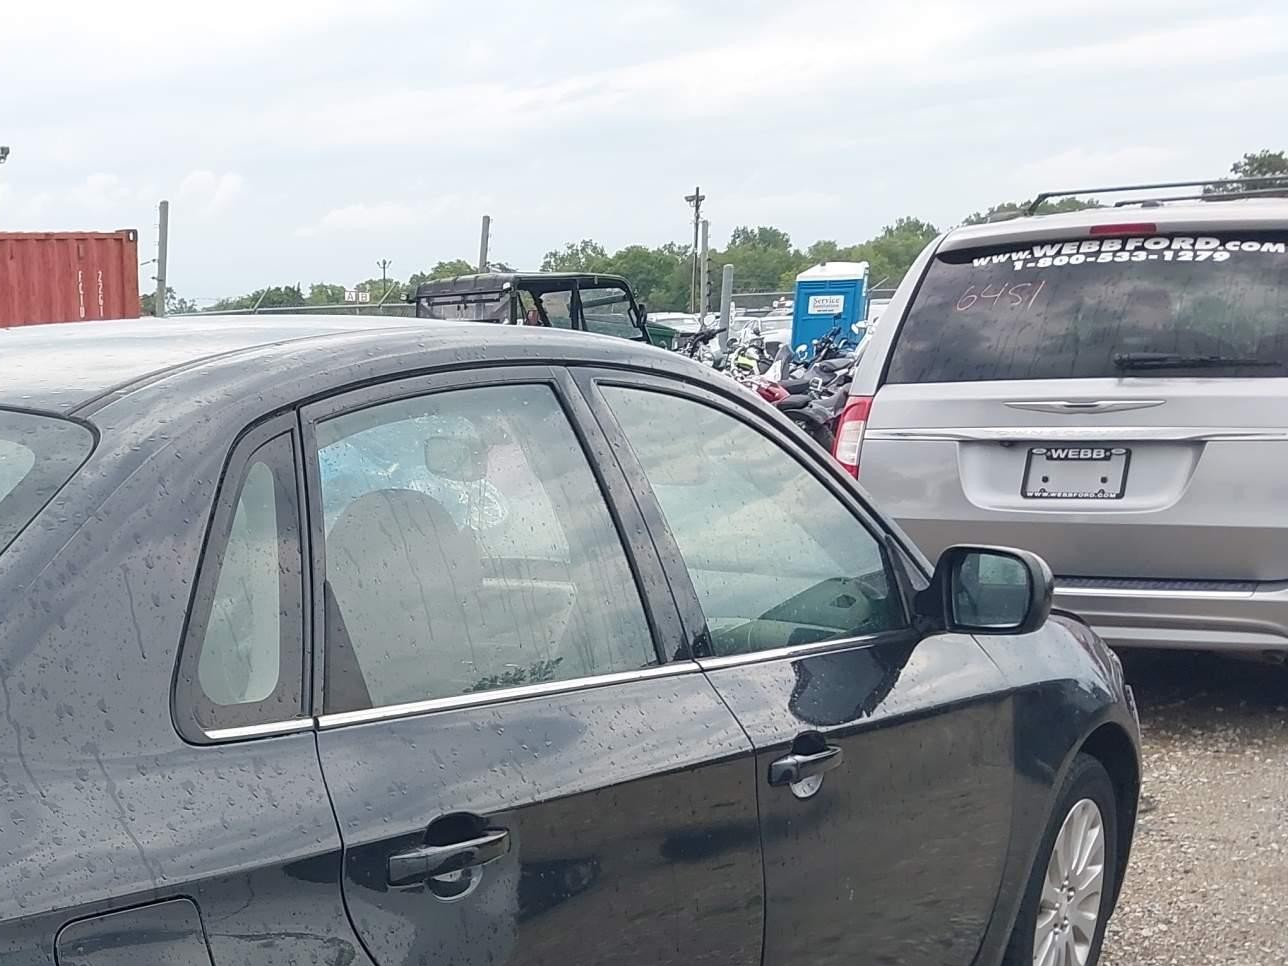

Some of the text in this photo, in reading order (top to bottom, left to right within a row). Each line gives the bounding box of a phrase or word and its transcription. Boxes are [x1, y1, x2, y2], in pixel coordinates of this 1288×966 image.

[1013, 250, 1231, 271] 1-800-533-1279
[956, 280, 1045, 311] 6451
[1051, 448, 1106, 459] WEBB
